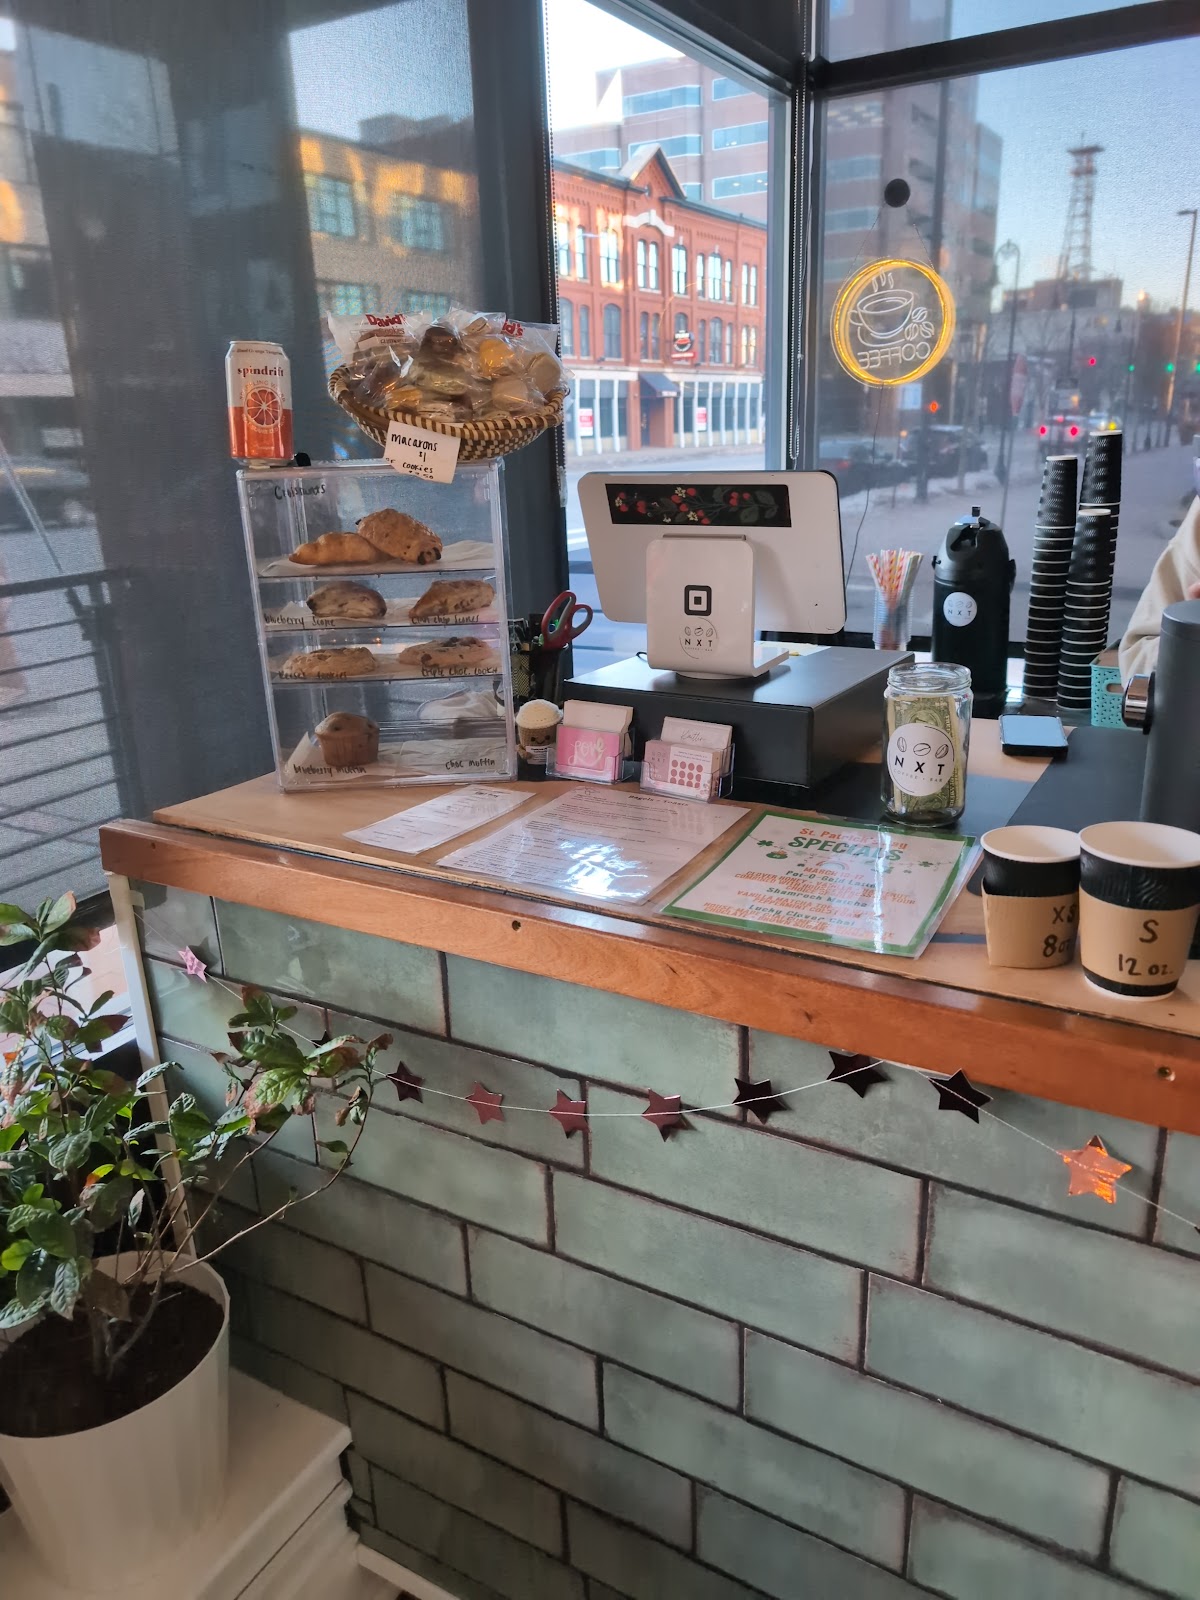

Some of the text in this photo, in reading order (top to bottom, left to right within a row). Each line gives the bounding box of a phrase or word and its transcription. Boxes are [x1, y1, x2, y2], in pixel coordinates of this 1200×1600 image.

[237, 366, 284, 377] spindrift
[391, 434, 438, 451] macarons
[402, 462, 434, 474] cookies
[684, 638, 712, 647] NXT
[894, 755, 945, 776] NXT
[894, 768, 918, 780] COFFEE
[800, 828, 816, 836] St.
[788, 836, 904, 861] SPECIALS
[1052, 904, 1078, 924] XS
[1138, 919, 1159, 943] S
[1118, 954, 1142, 976] 12
